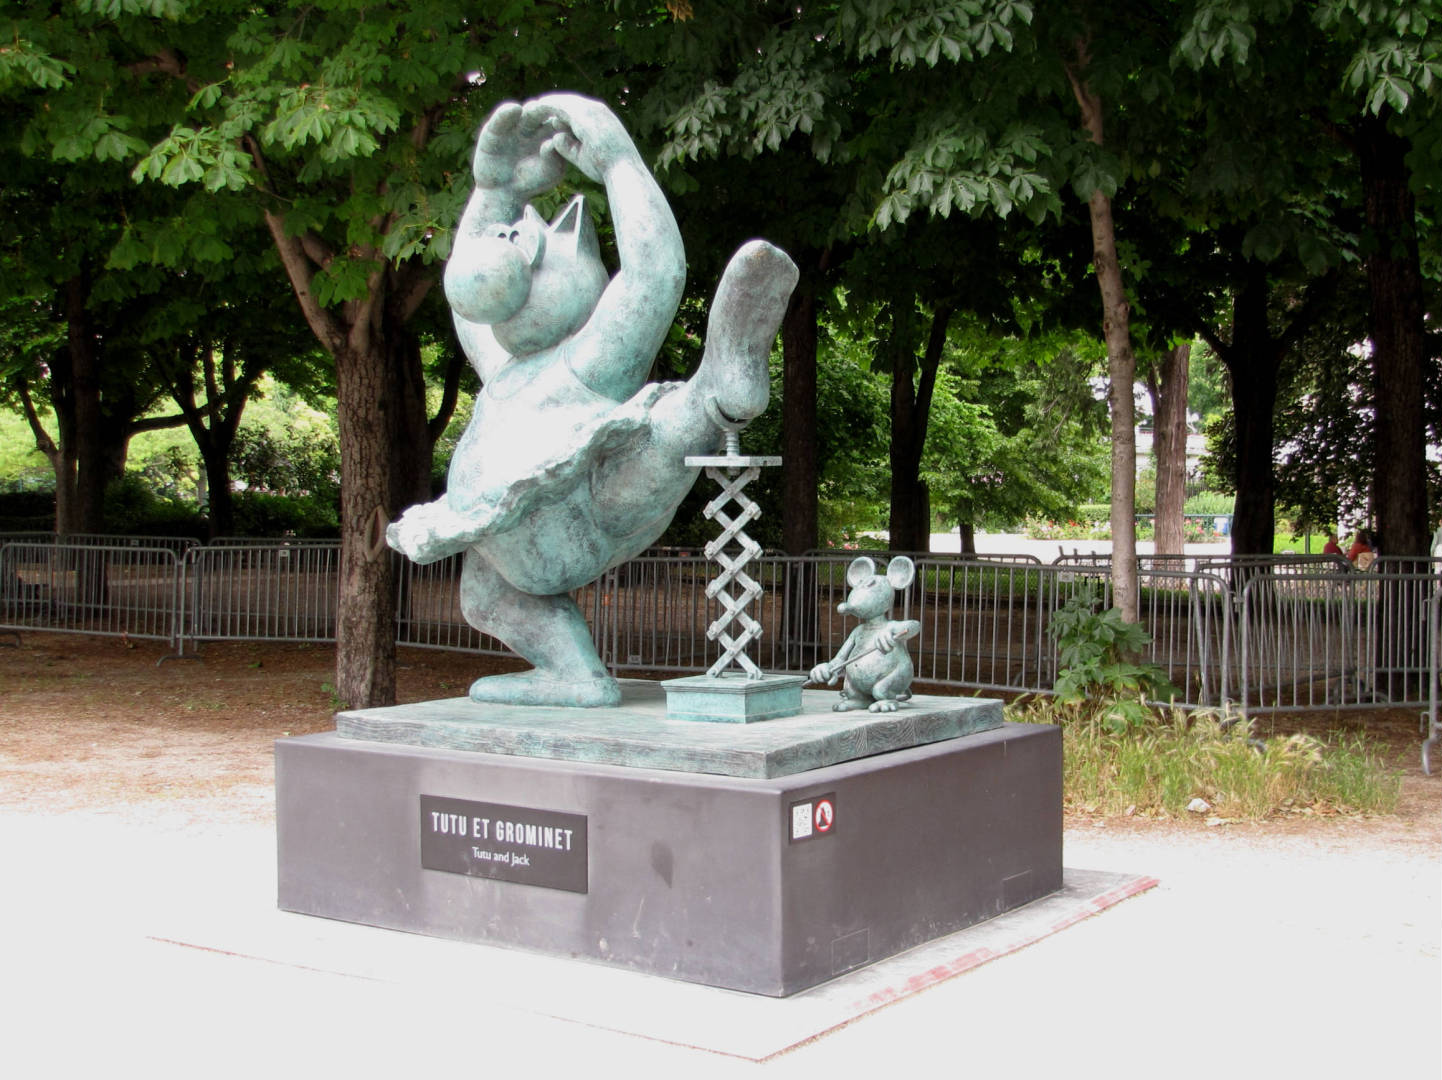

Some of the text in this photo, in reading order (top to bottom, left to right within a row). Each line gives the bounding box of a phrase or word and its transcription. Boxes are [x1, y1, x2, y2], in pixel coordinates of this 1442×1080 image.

[432, 812, 573, 850] TUTU ET GROMINET
[472, 847, 530, 867] Tutu and Jack
